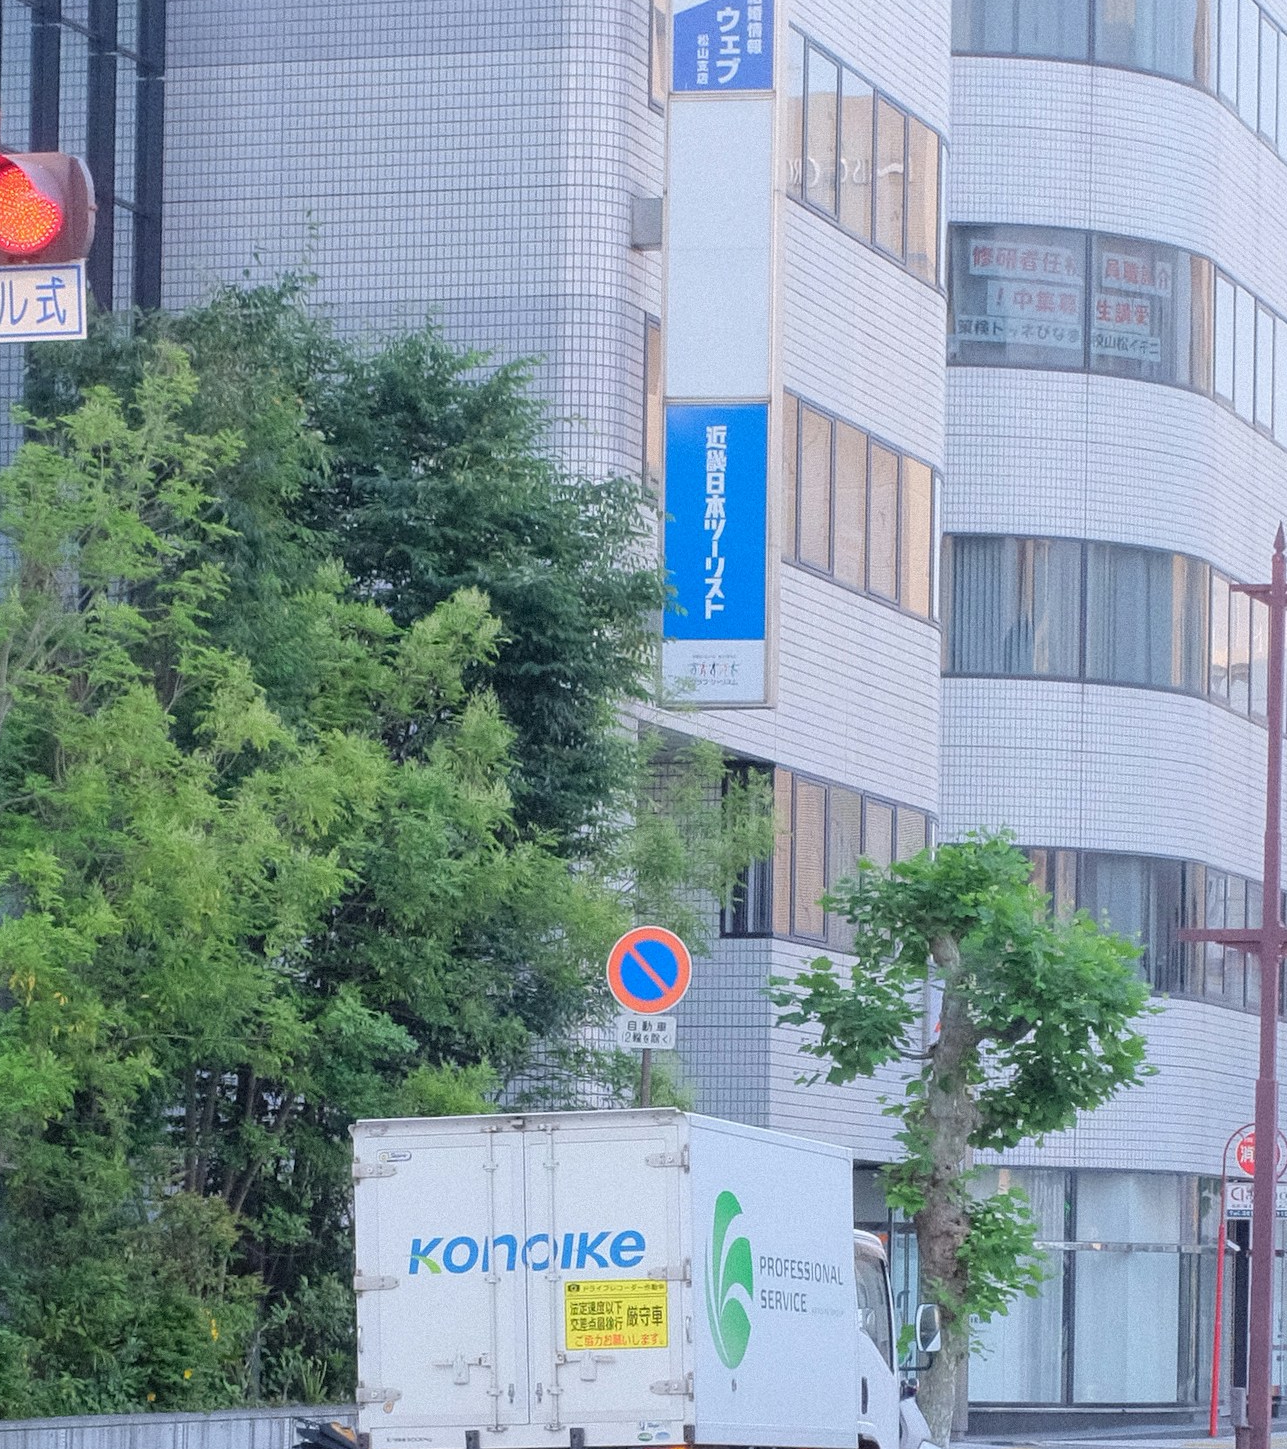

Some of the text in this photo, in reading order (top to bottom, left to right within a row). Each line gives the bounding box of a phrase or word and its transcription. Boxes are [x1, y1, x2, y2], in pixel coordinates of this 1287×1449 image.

[703, 424, 728, 621] 近畿日本ツーリスト
[627, 1020, 667, 1032] 自動車
[759, 1255, 844, 1286] PROFESSIONAL
[570, 1300, 624, 1316] 法定速度以下
[760, 1288, 808, 1313] SERVICE
[626, 1304, 664, 1327] 厳守車
